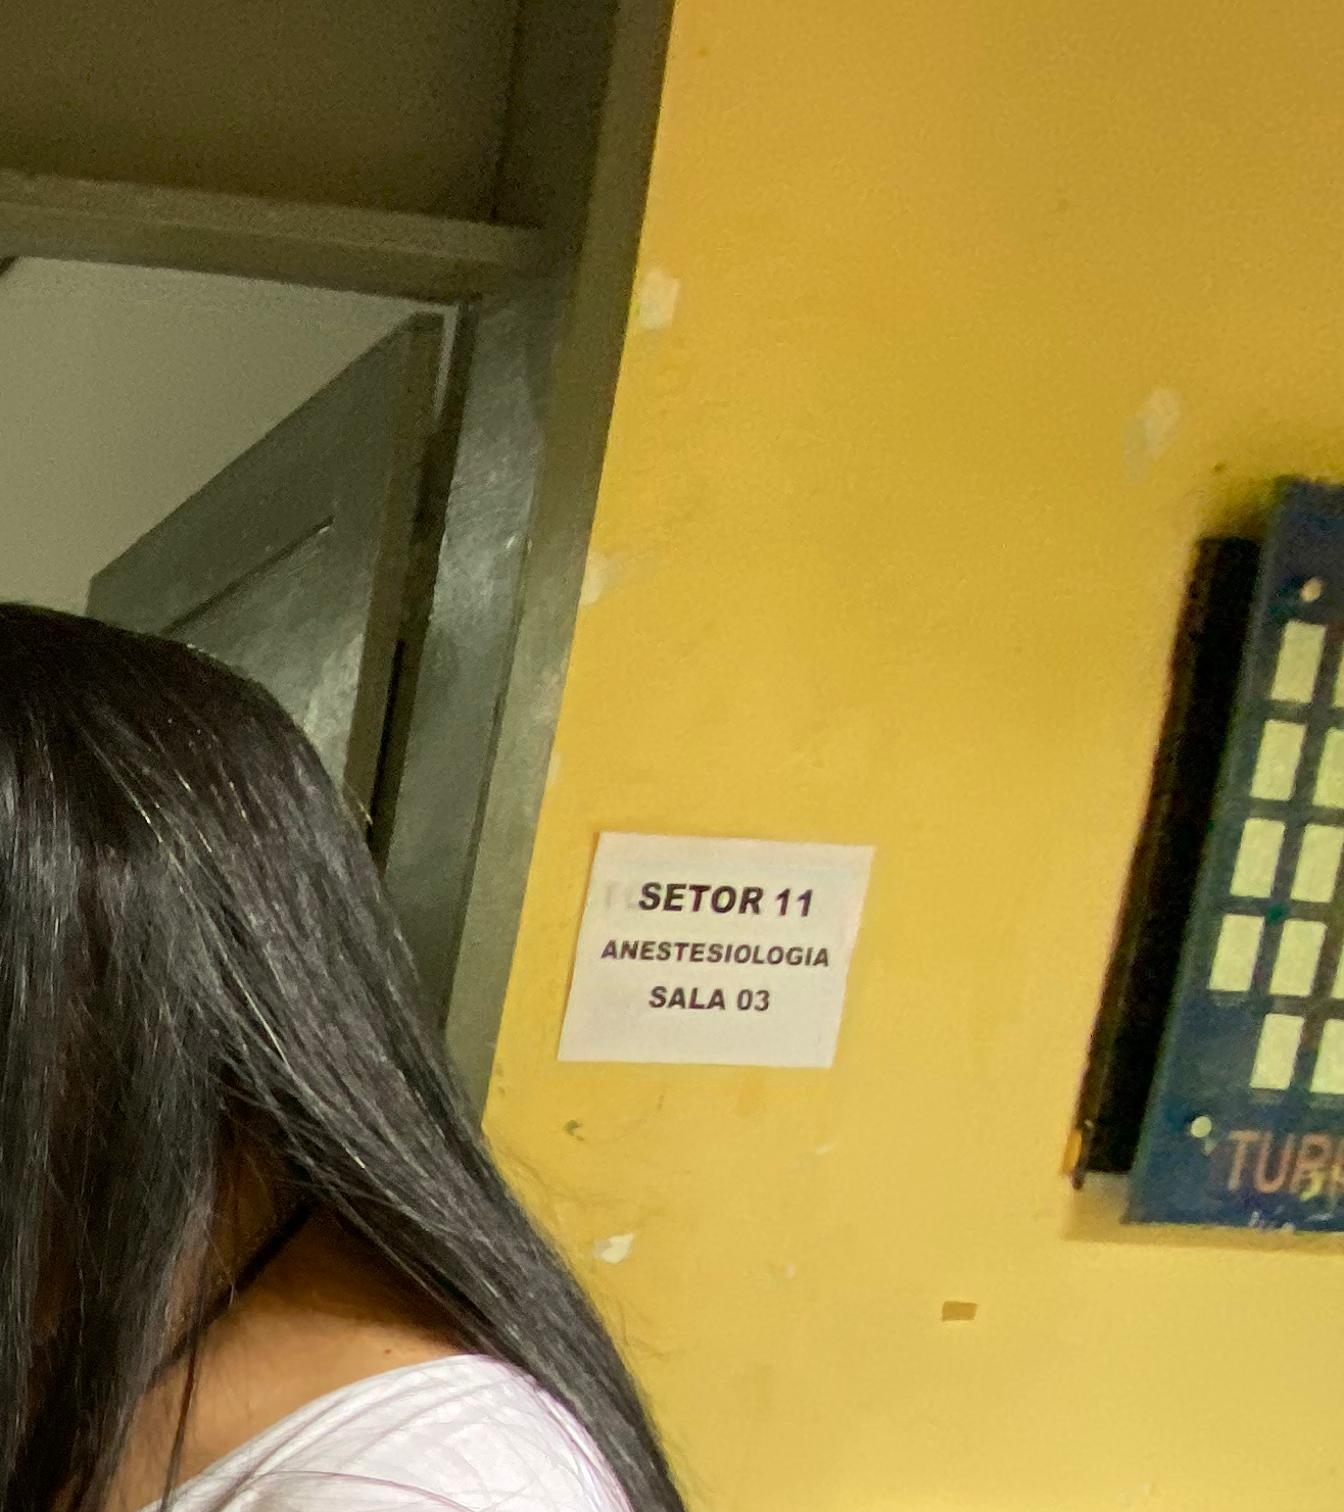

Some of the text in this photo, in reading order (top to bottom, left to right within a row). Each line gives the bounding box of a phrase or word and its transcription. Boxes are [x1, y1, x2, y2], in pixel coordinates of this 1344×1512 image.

[638, 882, 813, 917] SETOR 11
[601, 939, 829, 967] ANESTESIOLOGIA
[648, 985, 770, 1011] SALA 03
